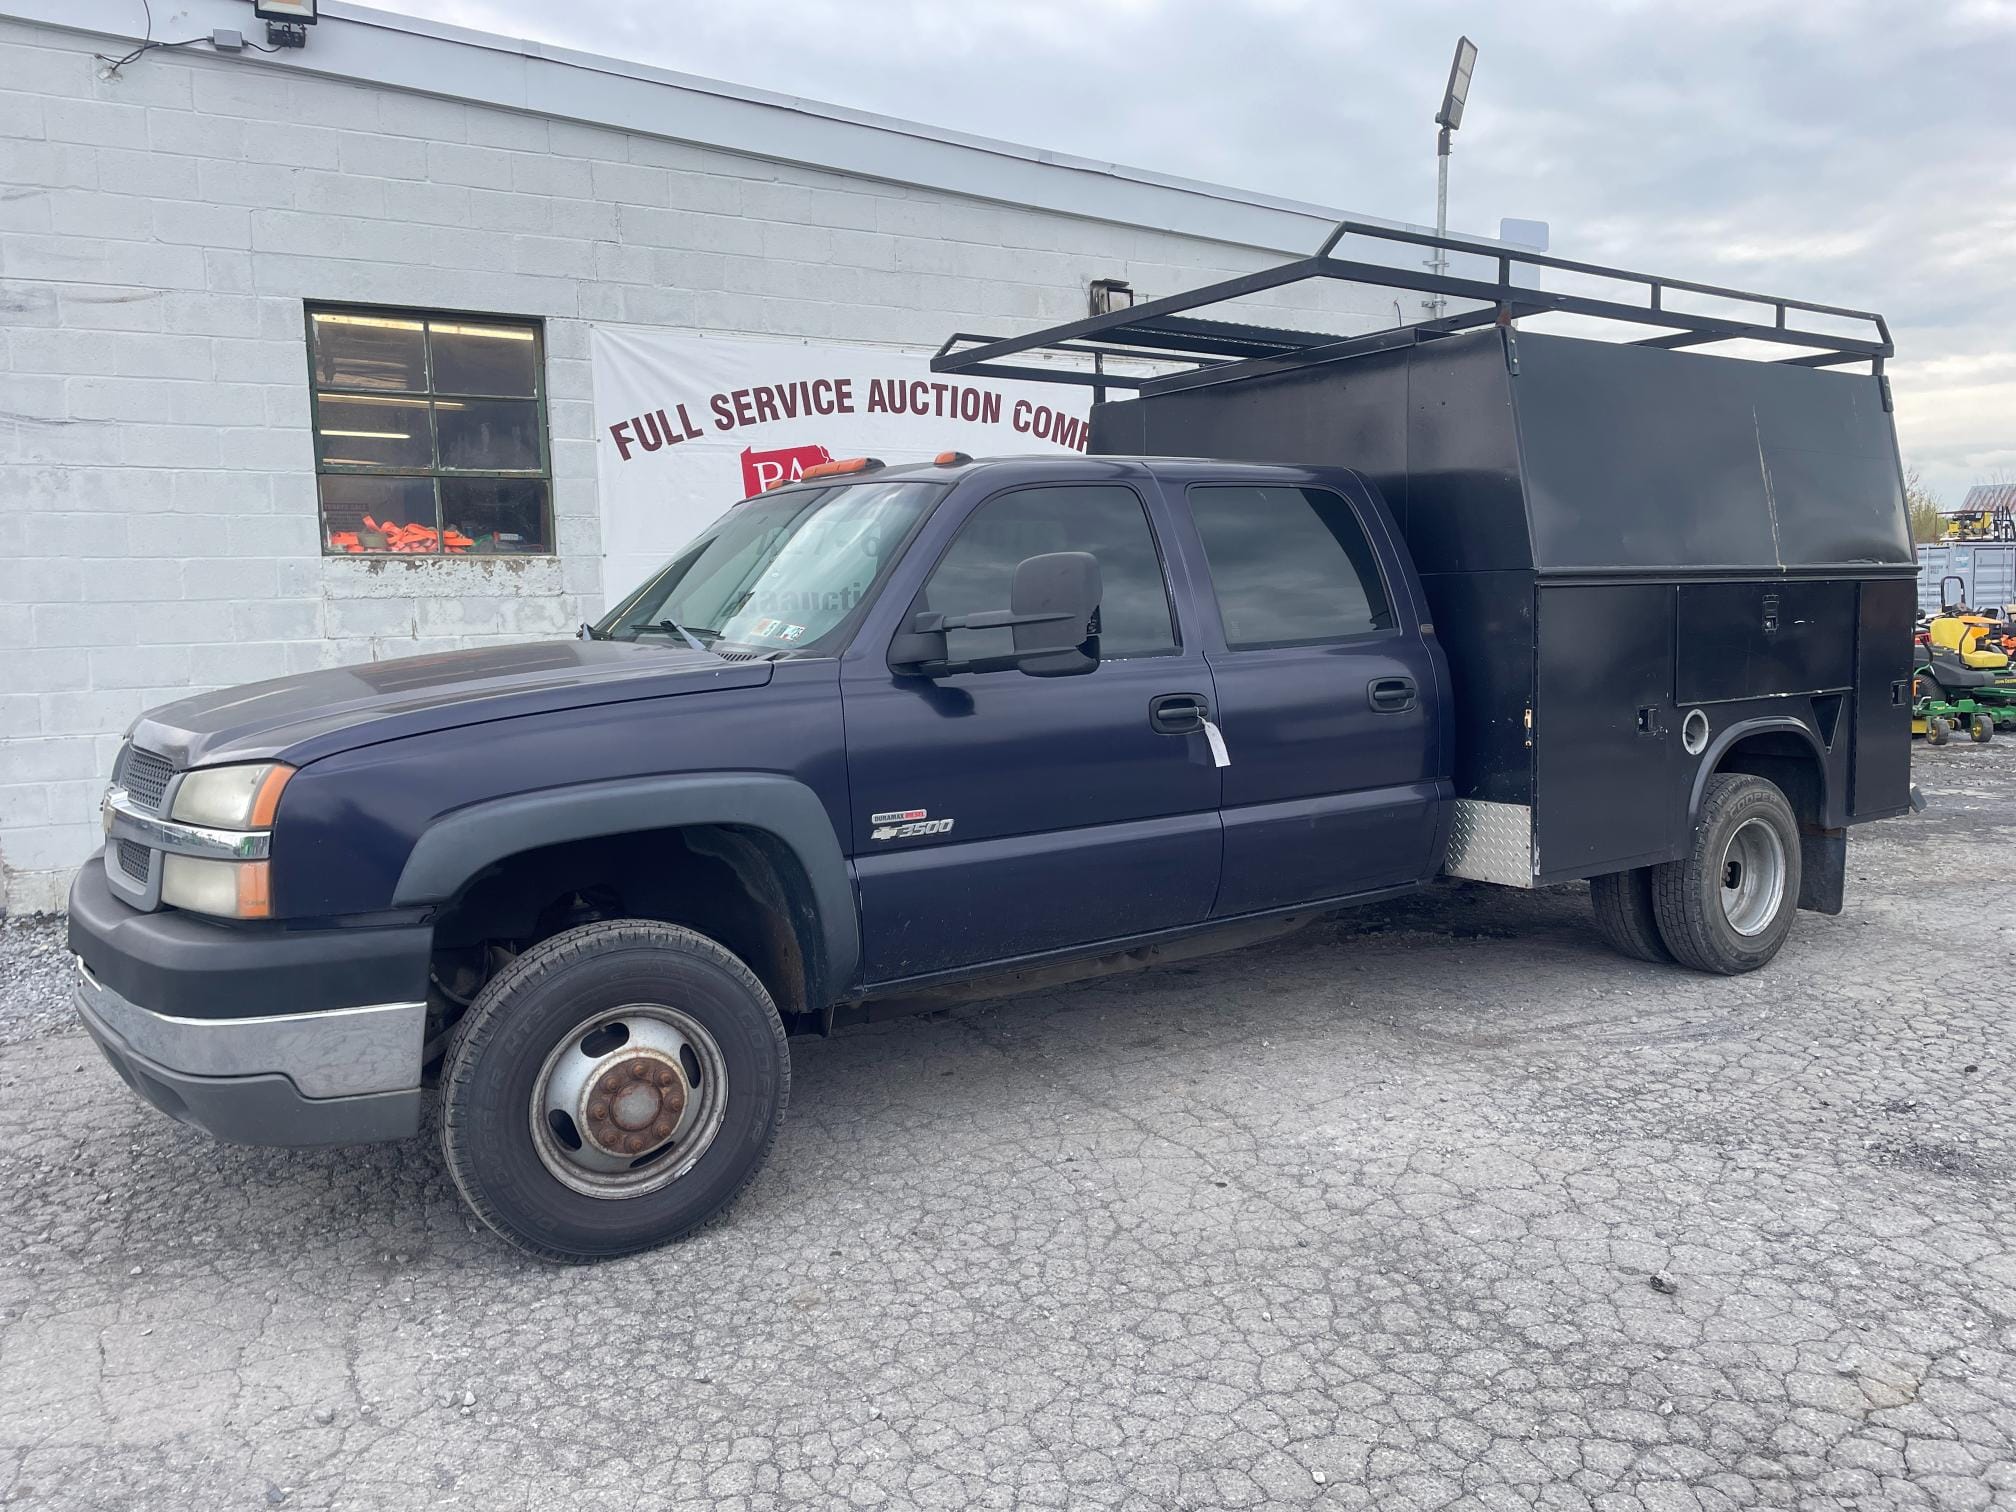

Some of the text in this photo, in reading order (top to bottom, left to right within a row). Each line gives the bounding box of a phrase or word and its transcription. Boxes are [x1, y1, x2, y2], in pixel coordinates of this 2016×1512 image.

[609, 404, 703, 460] FULL
[711, 378, 854, 430] SERVICE
[868, 378, 1002, 423] AUCTION
[1730, 792, 1777, 817] COOPER
[874, 813, 904, 822] DURAMAX
[899, 819, 954, 838] 3500
